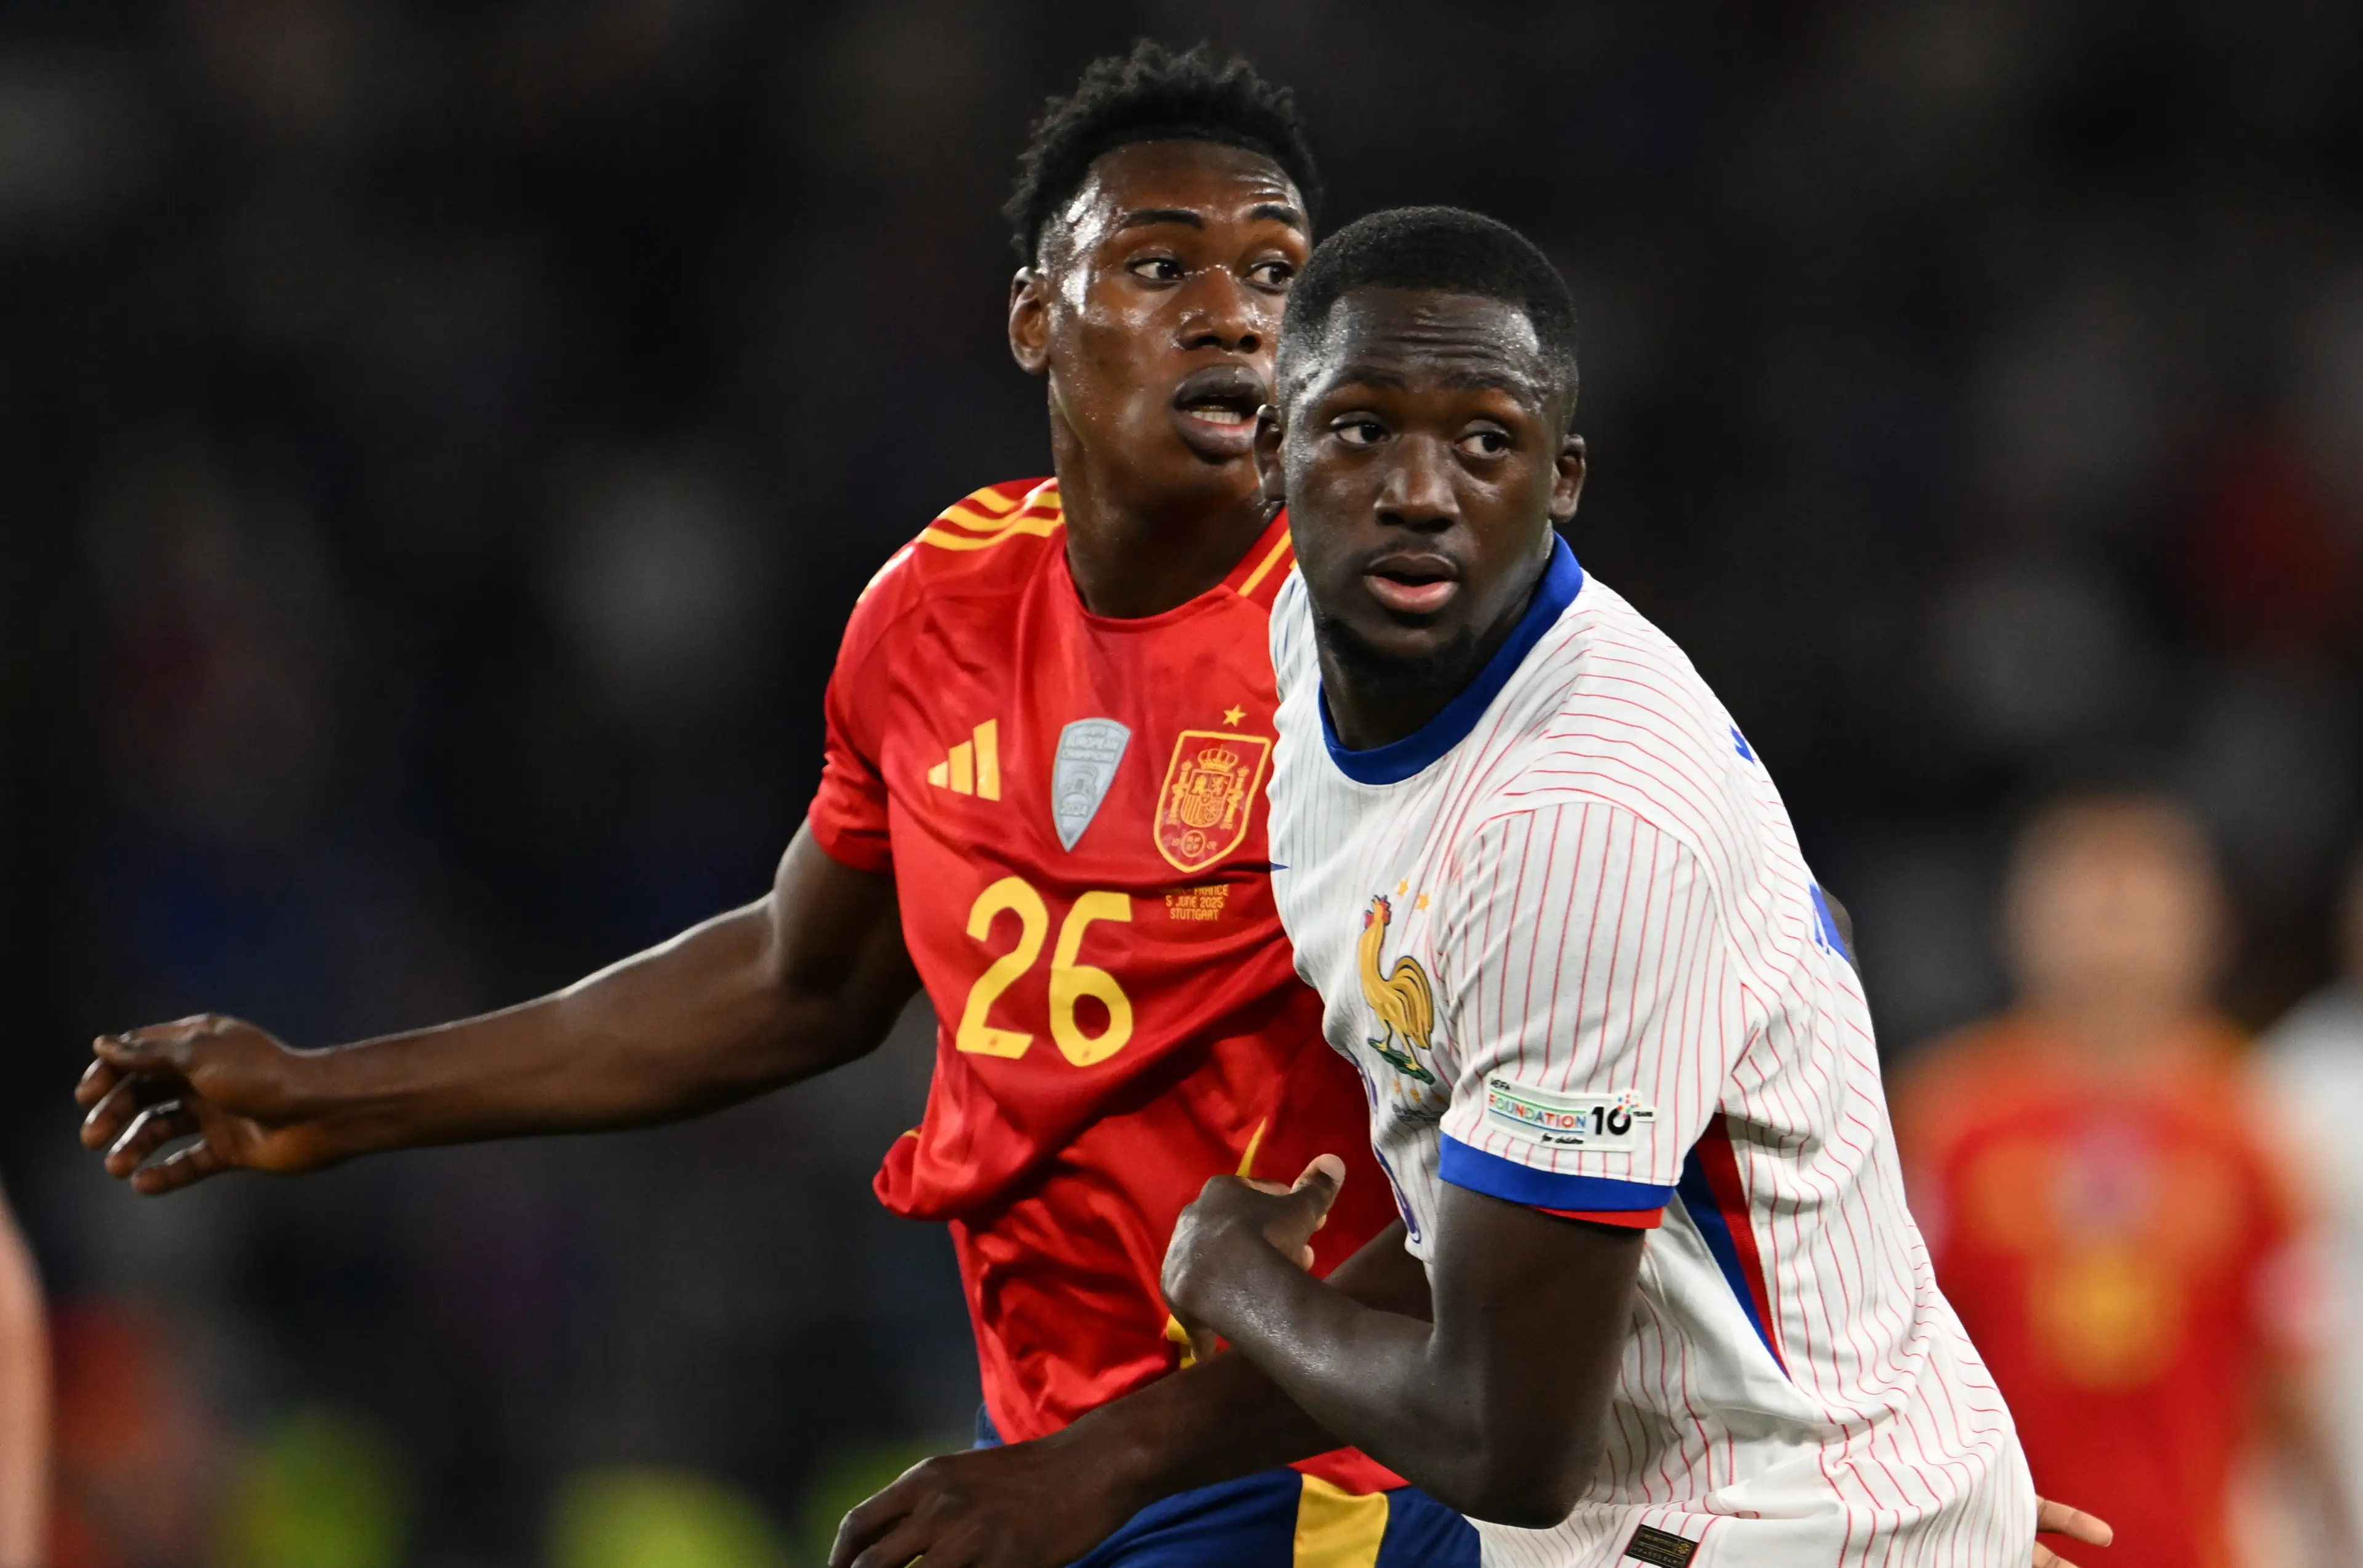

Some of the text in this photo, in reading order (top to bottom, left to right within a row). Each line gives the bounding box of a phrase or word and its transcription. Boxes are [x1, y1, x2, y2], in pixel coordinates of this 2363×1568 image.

[1166, 895, 1224, 909] 5 JUNE 2025
[1170, 908, 1218, 921] STUTTGART
[955, 876, 1134, 1067] 26
[1489, 1094, 1587, 1129] FOUNDATION
[1591, 1106, 1631, 1136] 10
